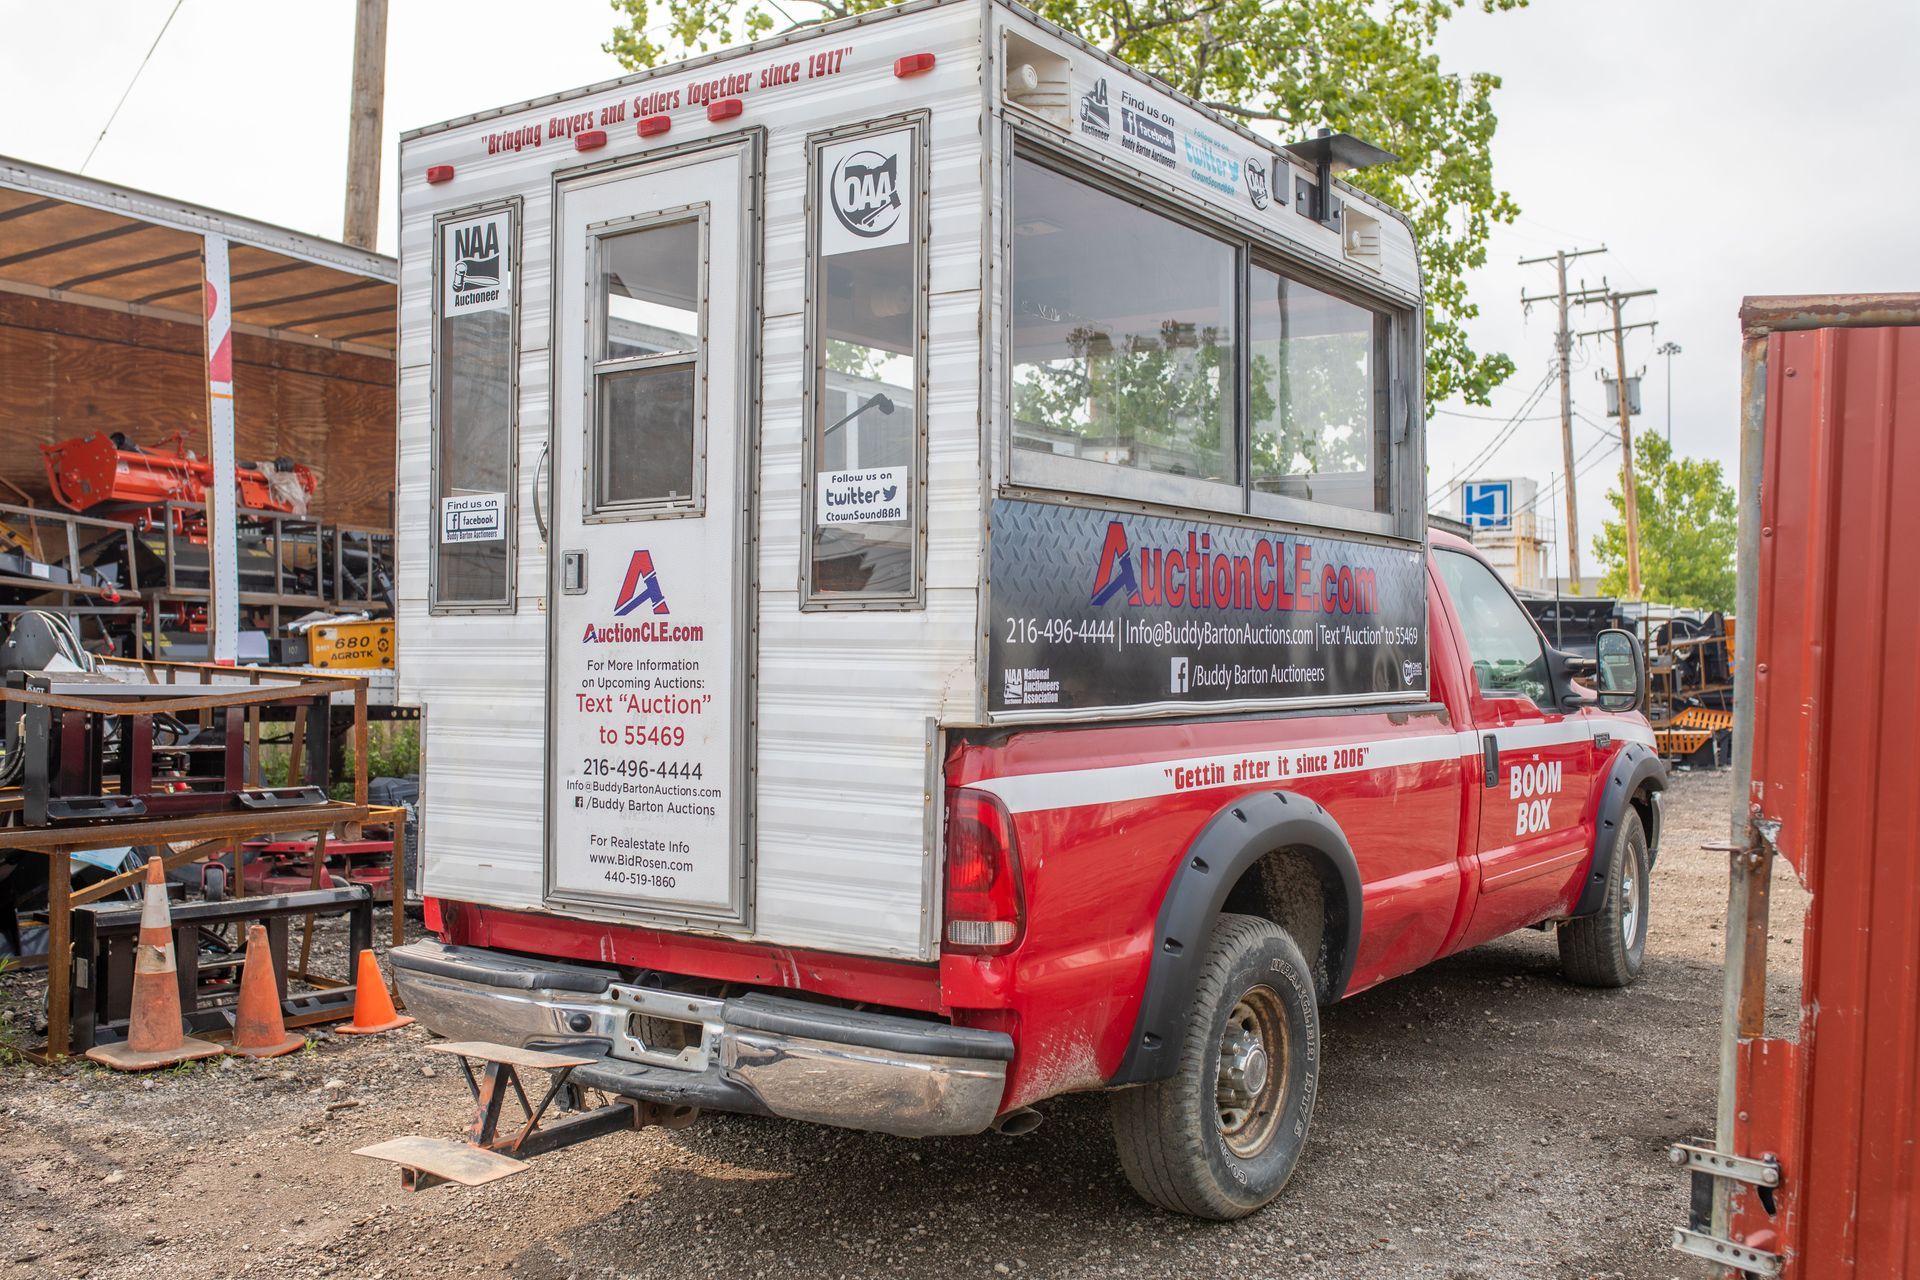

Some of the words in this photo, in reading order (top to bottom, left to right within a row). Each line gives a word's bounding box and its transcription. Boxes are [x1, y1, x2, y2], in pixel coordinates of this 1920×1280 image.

[481, 124, 542, 155] "Bringing
[548, 110, 594, 139] Buyers
[600, 99, 626, 126] and
[633, 88, 681, 119] Sellers
[687, 71, 753, 106] Together
[760, 61, 801, 89] since
[808, 46, 853, 79] 1917"
[1121, 90, 1145, 111] Find
[1146, 105, 1159, 119] us
[1161, 112, 1175, 127] on
[1139, 120, 1173, 148] facebook
[1121, 134, 1136, 154] Buddy
[1135, 141, 1151, 159] Barton
[1151, 147, 1177, 170] Auctioneers
[1184, 133, 1227, 177] twitter
[842, 171, 894, 213] OAA
[455, 222, 500, 262] NAA
[454, 289, 500, 307] Auctioneer
[832, 474, 863, 484] Follow
[866, 473, 877, 481] us
[880, 472, 892, 480] on
[447, 500, 468, 510] Find
[470, 501, 482, 509] us
[484, 500, 498, 508] on
[826, 486, 880, 507] twitter
[463, 514, 494, 526] facebook
[825, 507, 901, 522] CtownSoundBBA
[1091, 520, 1379, 615] AuctionCLE.com
[335, 635, 370, 649] 680
[582, 621, 704, 643] AuctionCLE.com
[1006, 617, 1115, 644] 216-496-4444
[1126, 619, 1314, 651] Info@BuddyBartonAuctions.com
[1320, 625, 1340, 645] Text
[1385, 627, 1394, 645] to
[1395, 626, 1418, 645] 55469
[331, 649, 374, 661] AGROTK
[587, 659, 605, 671] For
[607, 659, 633, 671] More
[636, 659, 699, 671] Information
[581, 678, 595, 688] on
[597, 677, 651, 690] Upcoming
[654, 677, 705, 689] Auctions:
[1004, 668, 1022, 684] NAA
[1023, 667, 1050, 680] National
[1191, 664, 1232, 691] /Buddy
[1234, 663, 1268, 685] Barton
[1270, 663, 1325, 684] Auctioneers
[1023, 680, 1060, 692] Auctioneers
[576, 693, 613, 713] Text
[1023, 692, 1059, 704] Association
[599, 725, 618, 745] to
[624, 725, 685, 747] 55469
[583, 758, 703, 780] 216-496-4444
[1164, 762, 1225, 790] "Gettin
[1233, 758, 1270, 782] after
[1277, 755, 1290, 776] it
[1296, 753, 1328, 774] since
[1333, 747, 1370, 770] 2006"
[566, 780, 722, 798] Info@BuddyBartonAuctions.com
[1510, 760, 1562, 800] BOOM
[586, 796, 625, 813] /Buddy
[628, 799, 664, 813] Barton
[667, 801, 716, 816] Auctions
[1515, 798, 1553, 836] BOX
[590, 834, 608, 847] For
[610, 835, 666, 852] Realestate
[669, 841, 690, 854] Info
[589, 853, 693, 872] www.BidRosen.com
[604, 871, 676, 888] 440-519-1860
[1270, 958, 1316, 1062] WRANGLER
